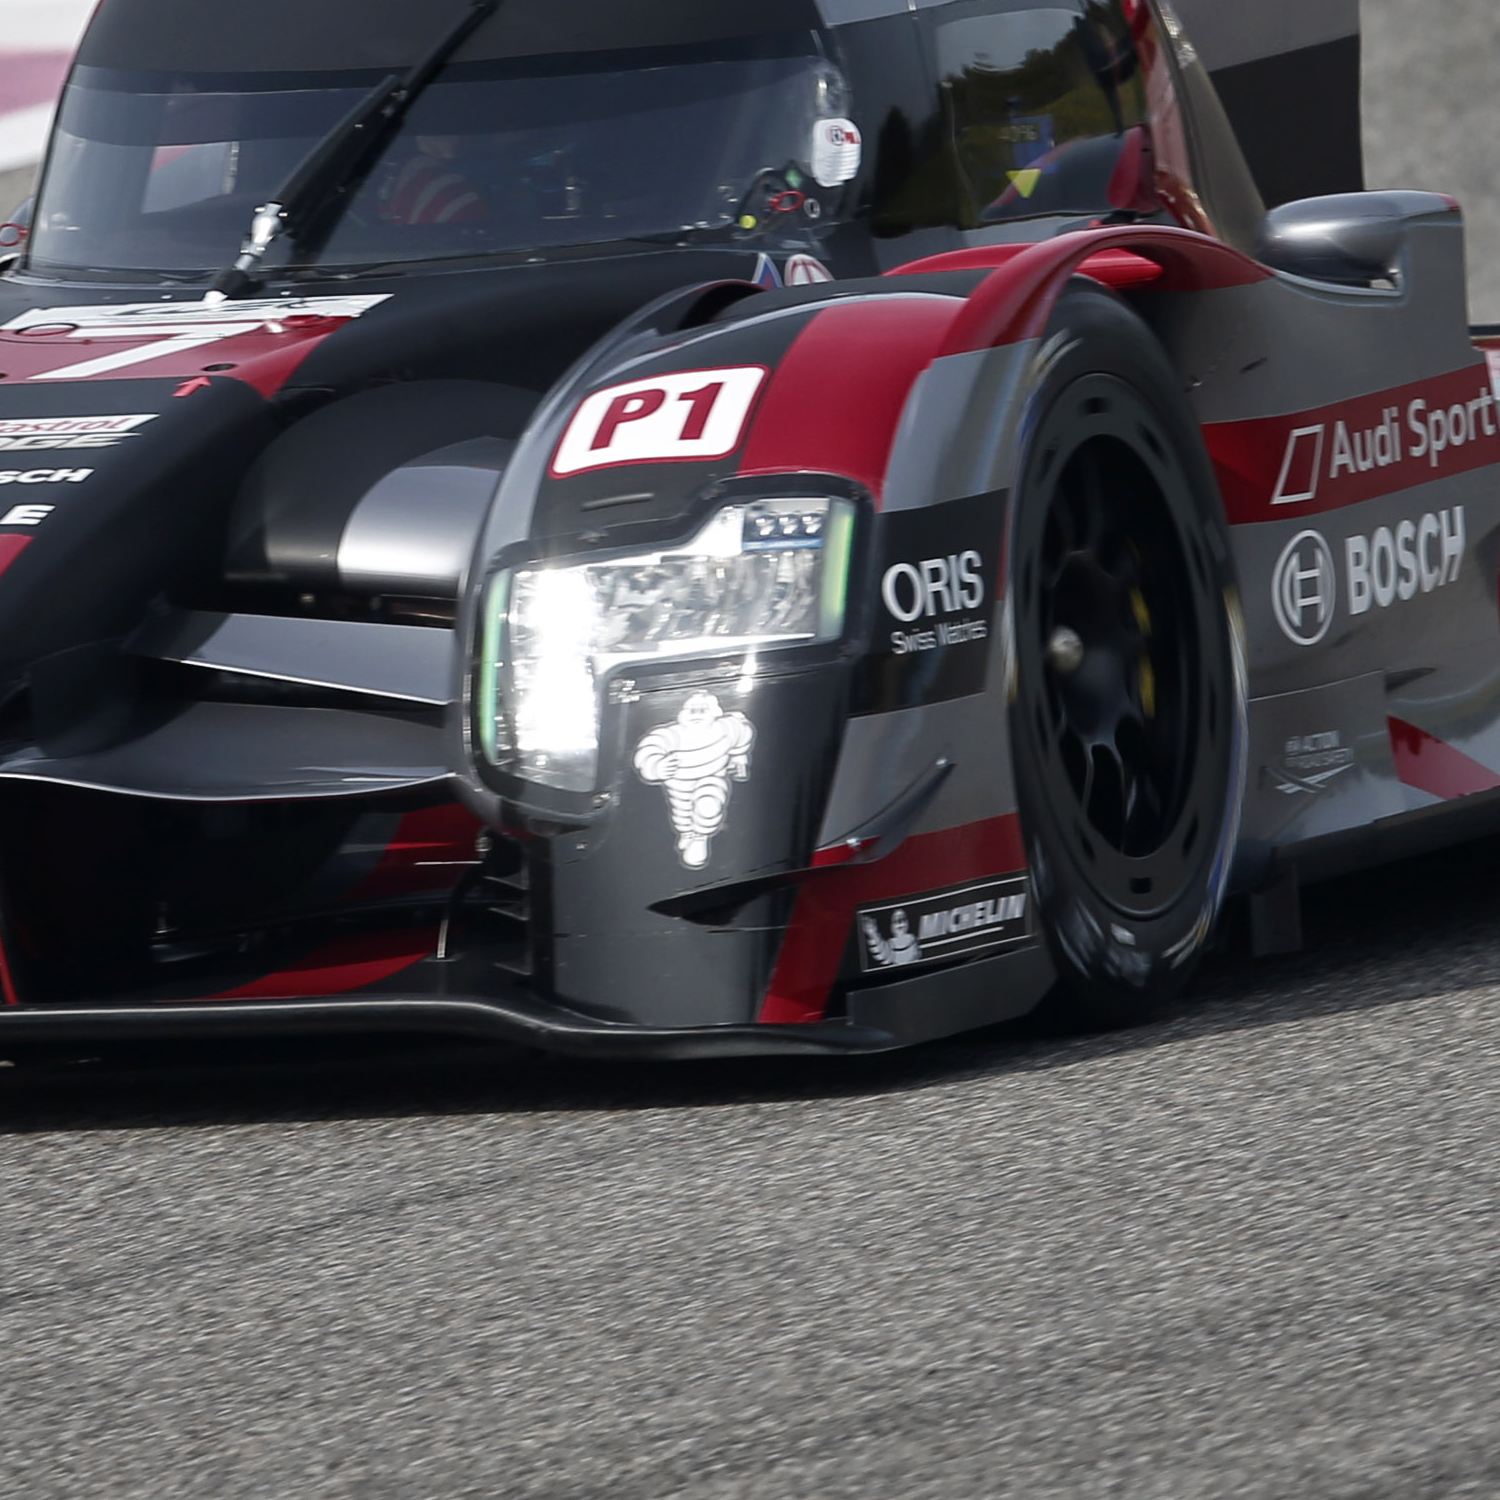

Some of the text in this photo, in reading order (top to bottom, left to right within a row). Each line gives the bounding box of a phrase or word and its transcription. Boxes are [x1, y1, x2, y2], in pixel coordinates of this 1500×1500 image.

[26, 320, 267, 380] 7
[589, 381, 725, 451] P1
[1329, 387, 1496, 479] Audi Sport
[881, 550, 985, 622] ORIS
[1344, 505, 1466, 616] BOSCH
